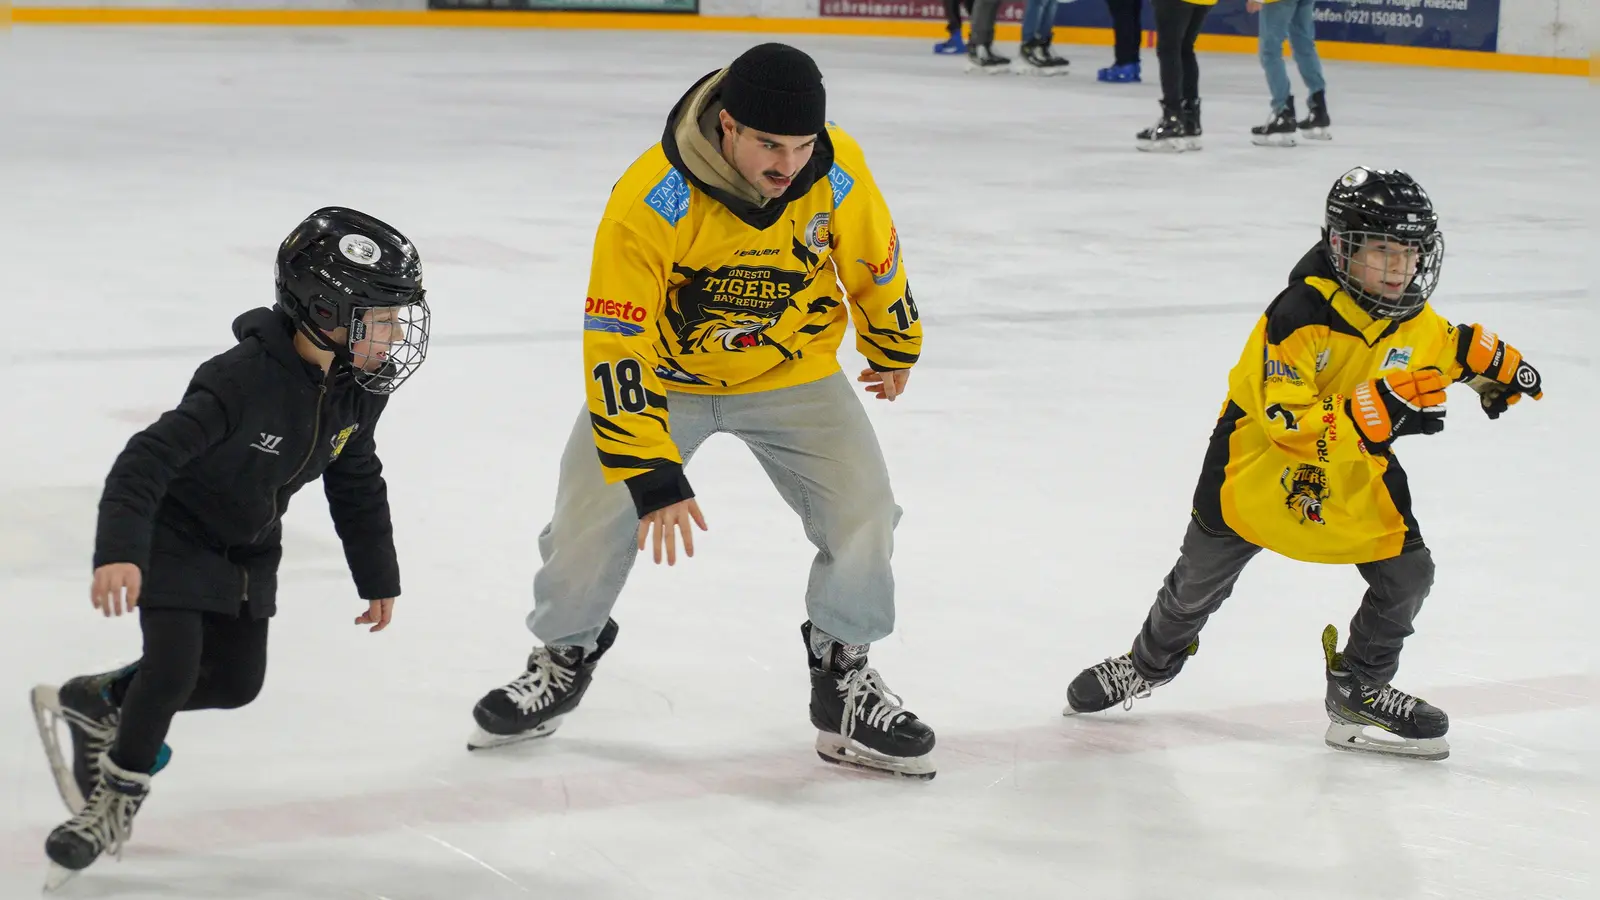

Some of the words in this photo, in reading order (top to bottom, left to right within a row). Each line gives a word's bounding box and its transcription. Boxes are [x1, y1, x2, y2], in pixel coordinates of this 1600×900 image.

[1344, 10, 1369, 24] 0921
[1371, 11, 1424, 28] 150830-0
[650, 169, 682, 209] STADT
[828, 167, 851, 190] ADT
[1396, 223, 1426, 232] CCM
[728, 269, 771, 279] ONESTO
[702, 276, 791, 300] TIGERS
[585, 296, 647, 323] onesto
[713, 294, 774, 309] BAYREUTH
[887, 278, 919, 331] 18
[592, 358, 648, 417] 18
